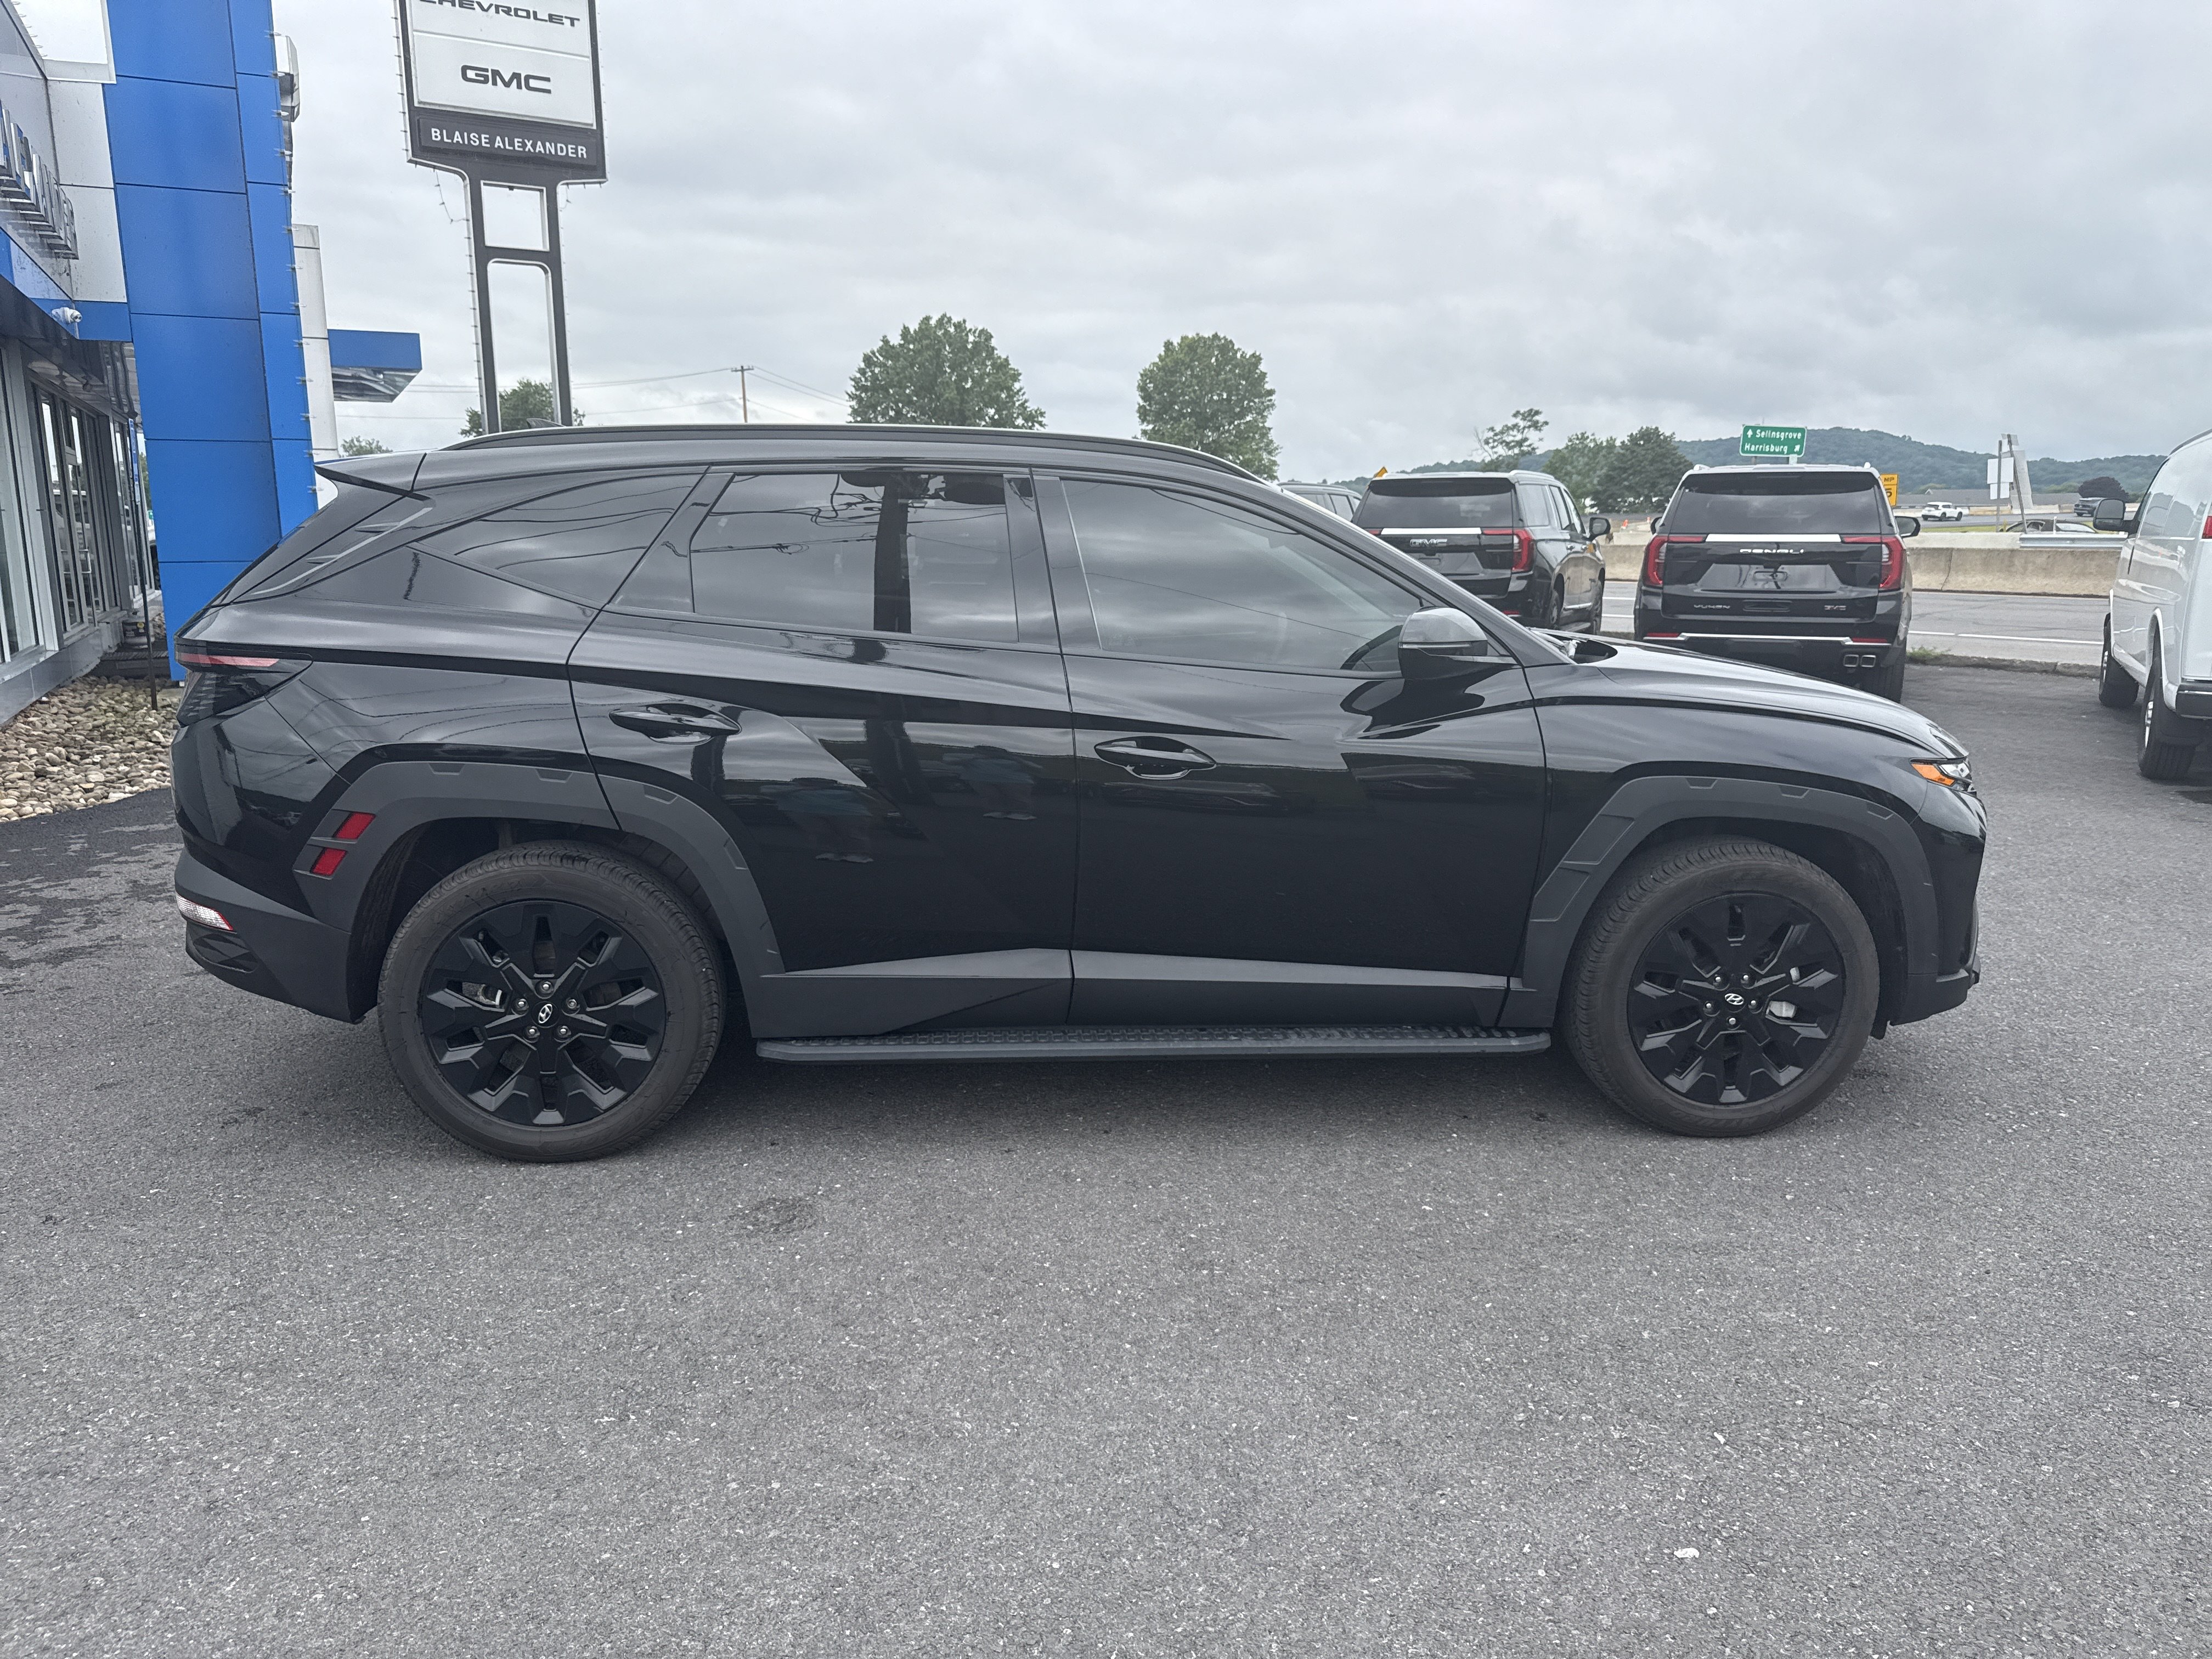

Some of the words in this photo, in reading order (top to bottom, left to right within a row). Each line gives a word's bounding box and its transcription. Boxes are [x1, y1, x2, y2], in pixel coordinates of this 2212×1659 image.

[461, 65, 552, 94] GMC
[431, 128, 490, 148] BLAISE
[494, 136, 588, 159] ALEXANDER
[1755, 429, 1802, 441] Selinsgrove
[1744, 443, 1788, 455] Harrisburg
